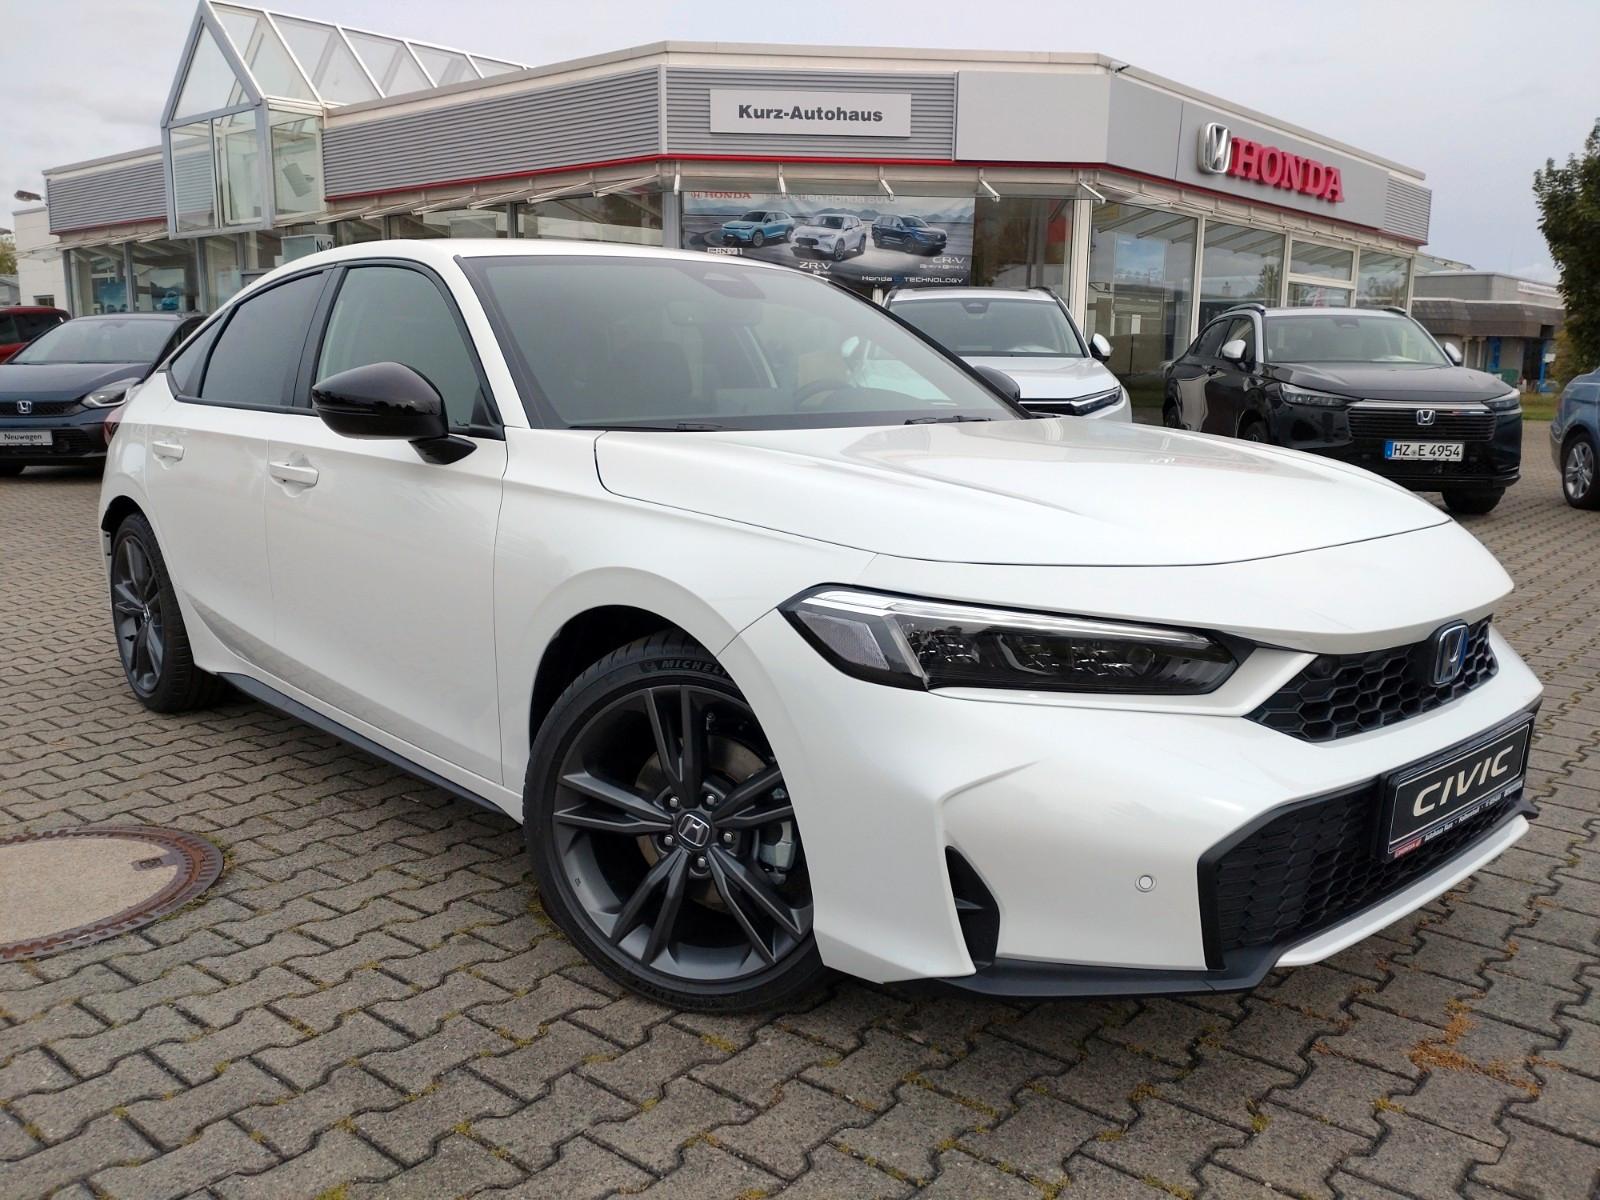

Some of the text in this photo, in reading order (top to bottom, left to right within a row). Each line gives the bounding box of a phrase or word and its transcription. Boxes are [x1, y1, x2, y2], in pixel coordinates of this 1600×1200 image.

[738, 105, 883, 121] Kurz-Autohaus
[1227, 137, 1344, 203] HONDA
[904, 276, 964, 284] TECHNOLOGY
[4, 433, 42, 441] Neuwagen
[1393, 444, 1461, 457] HZ E 4954
[1412, 745, 1514, 817] CIVIC
